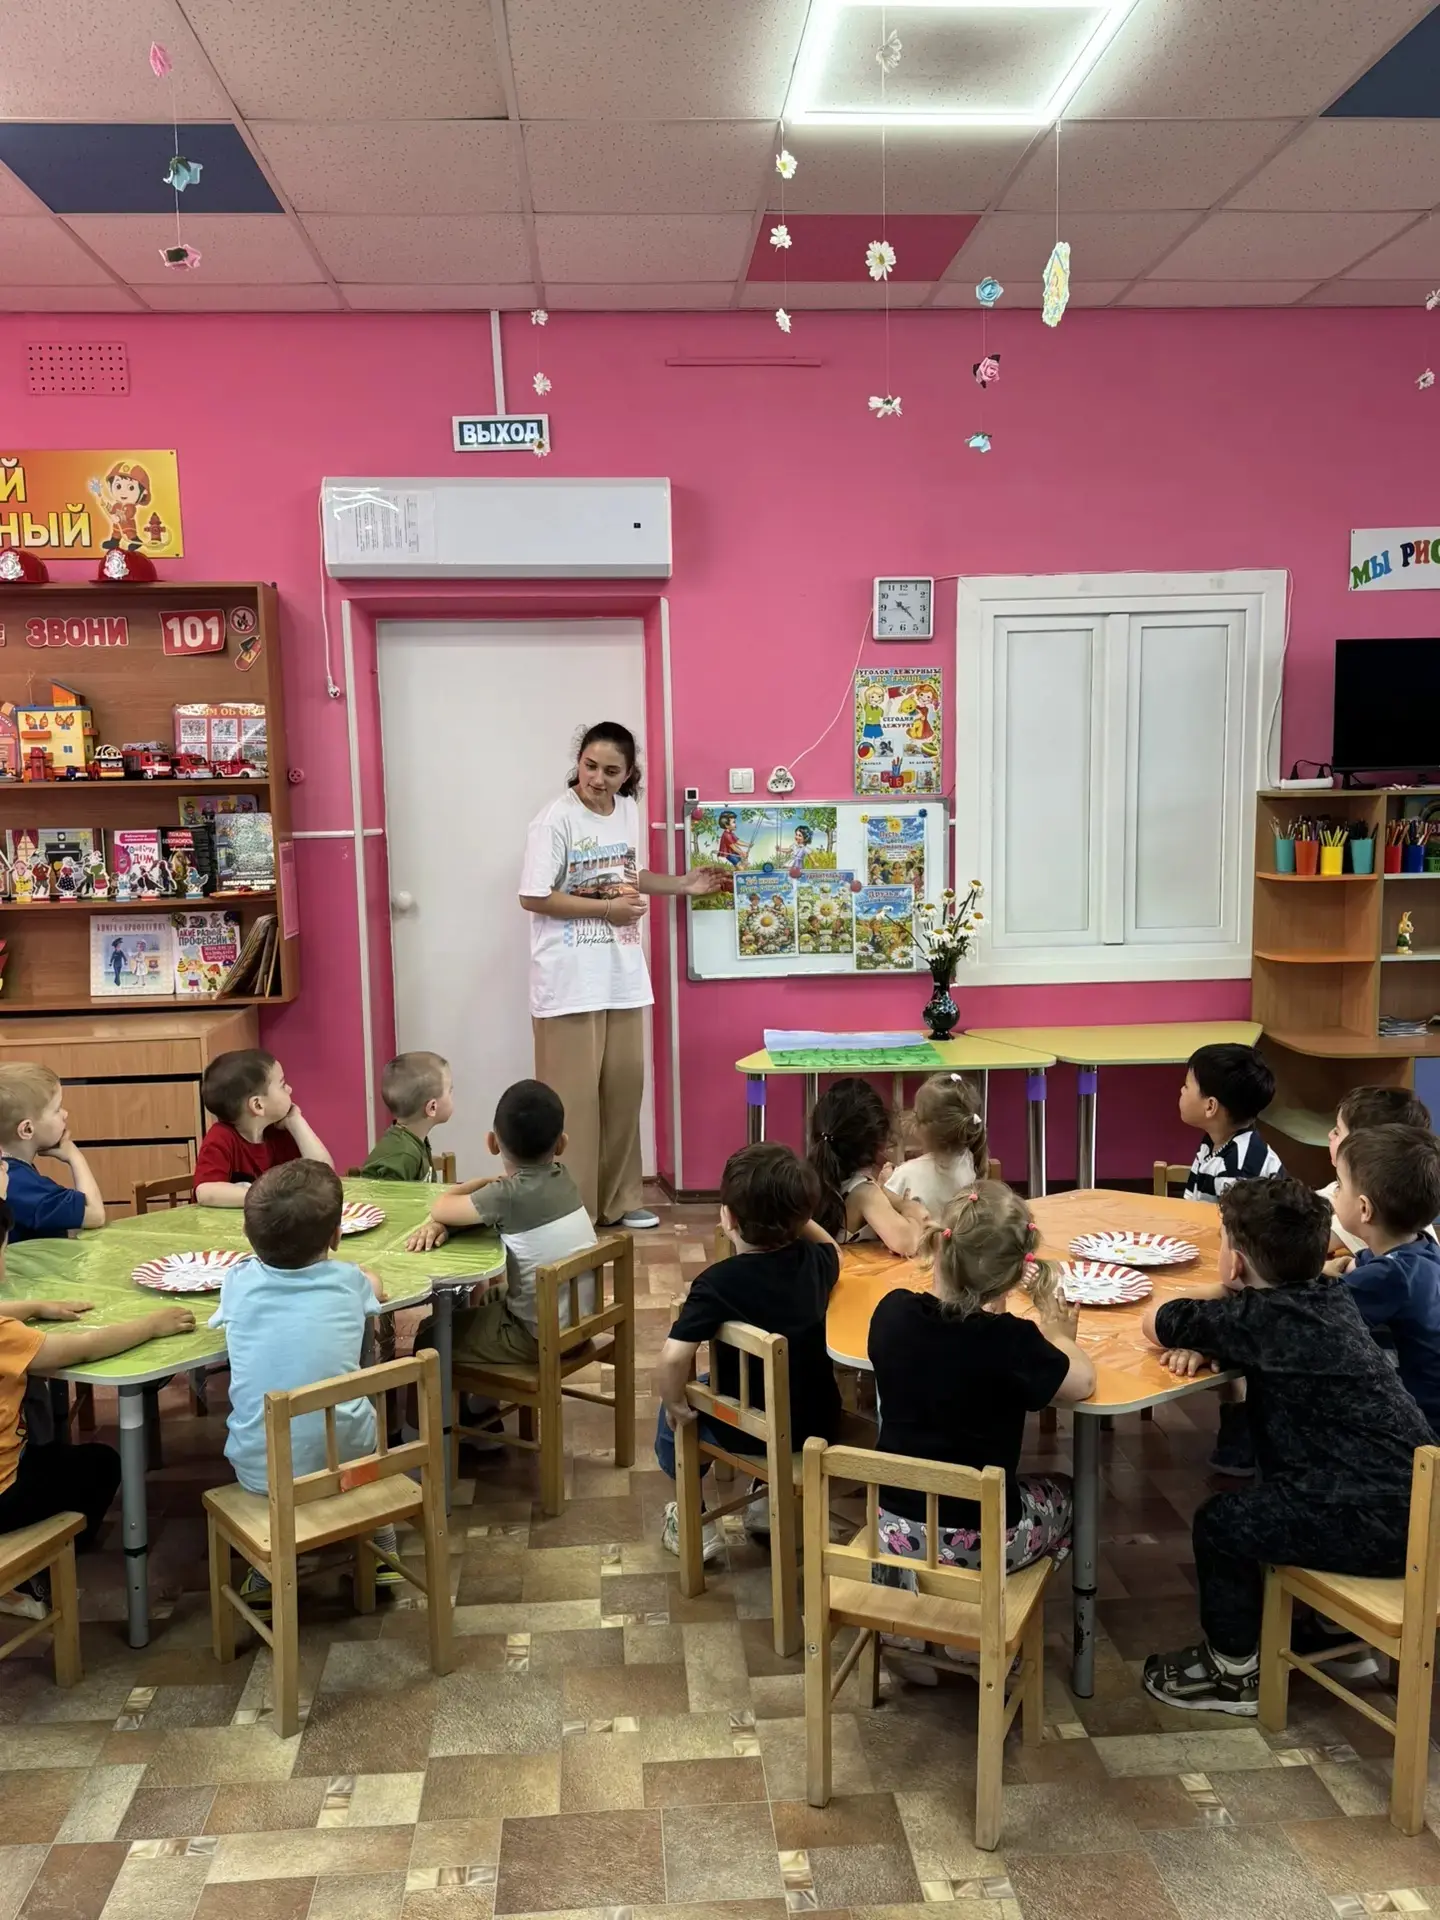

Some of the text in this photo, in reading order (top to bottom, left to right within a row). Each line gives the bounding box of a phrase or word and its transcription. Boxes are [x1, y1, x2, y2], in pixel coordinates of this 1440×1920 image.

[463, 422, 540, 443] ВЫХОД
[1351, 550, 1392, 589] МЫ
[881, 592, 889, 600] 10
[920, 591, 926, 599] 2
[920, 604, 926, 612] 3
[880, 616, 887, 624] 8
[26, 617, 128, 648] ЗВОНИ
[166, 615, 219, 648] 101
[576, 933, 617, 947] Perfection
